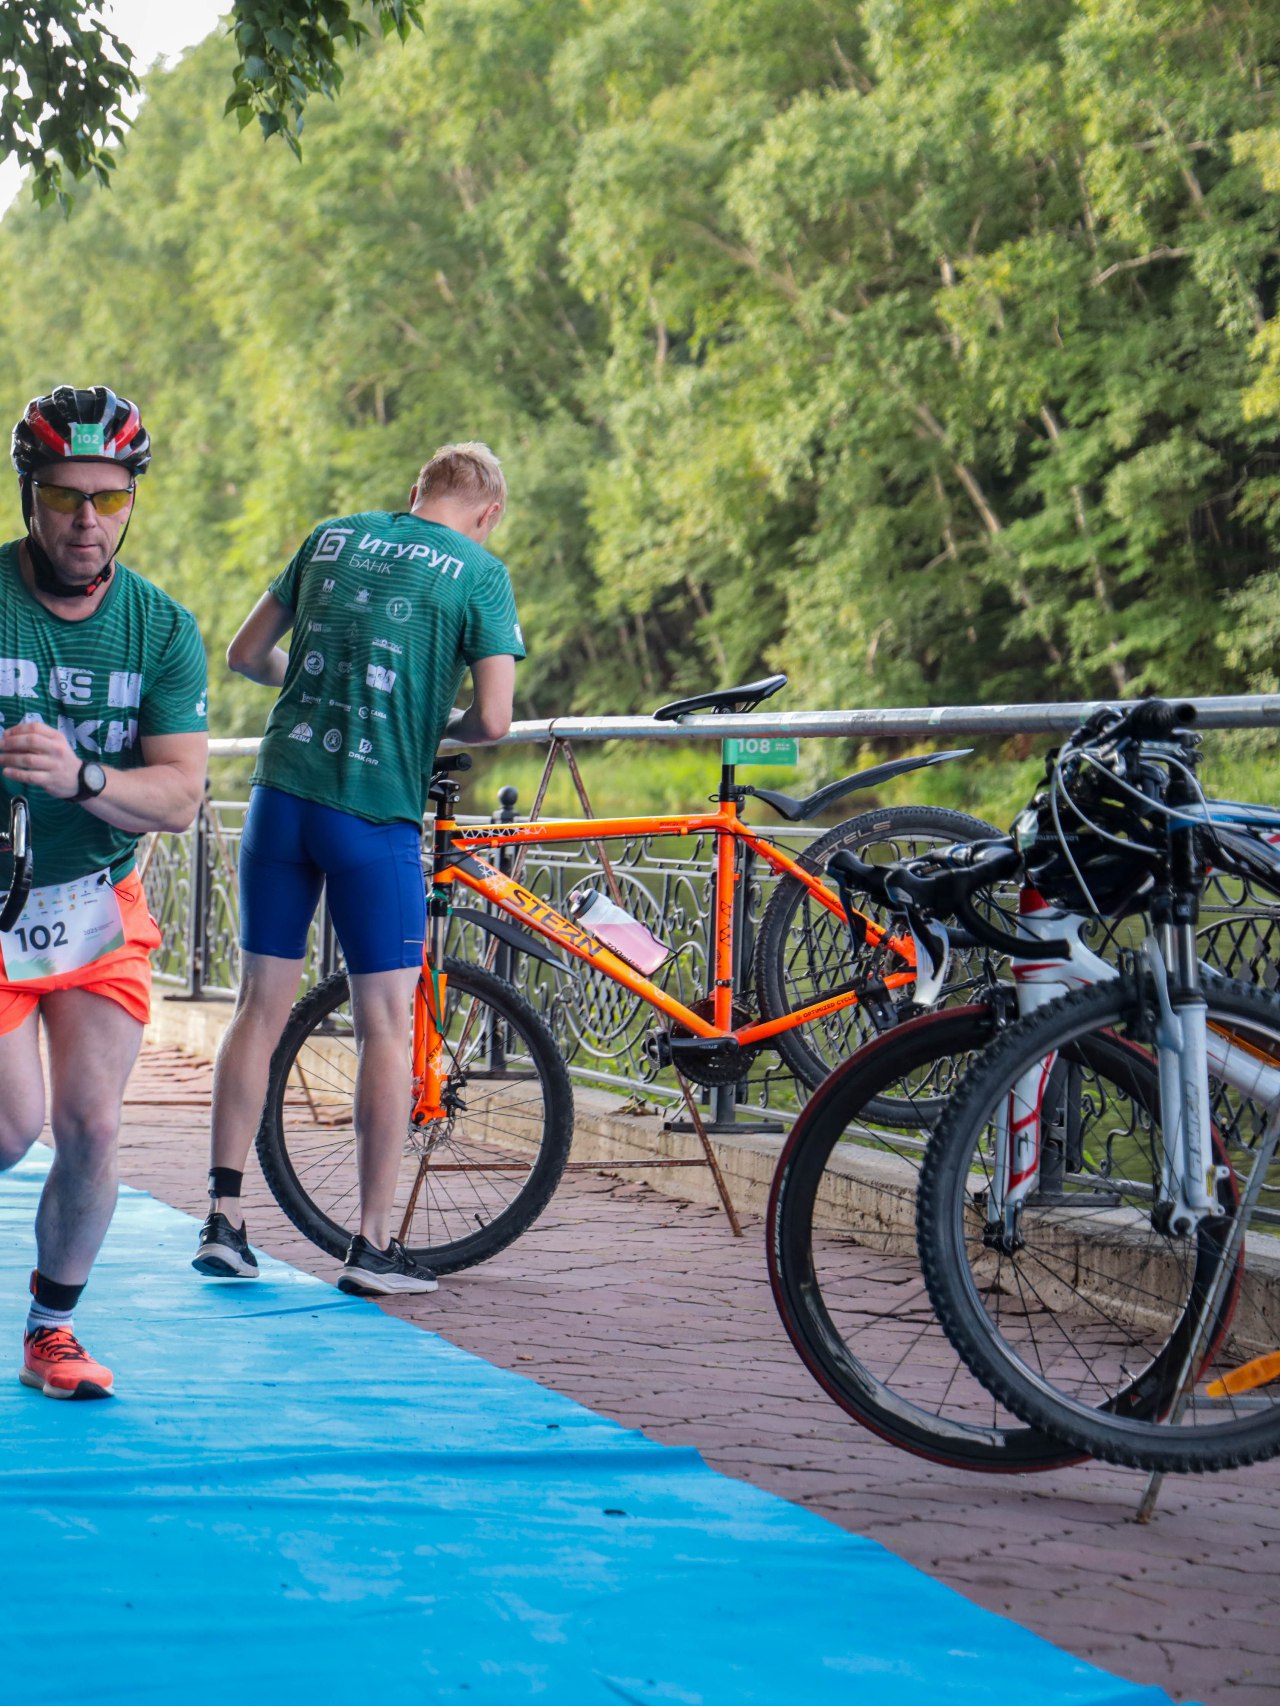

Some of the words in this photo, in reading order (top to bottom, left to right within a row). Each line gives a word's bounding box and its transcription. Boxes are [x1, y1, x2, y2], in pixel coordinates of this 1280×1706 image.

[77, 433, 100, 445] 102
[349, 553, 396, 575] БАНК
[358, 533, 465, 580] ИТУРУП
[737, 738, 771, 754] 108
[815, 820, 892, 865] STELS
[14, 921, 69, 953] 102
[505, 889, 605, 957] STERN
